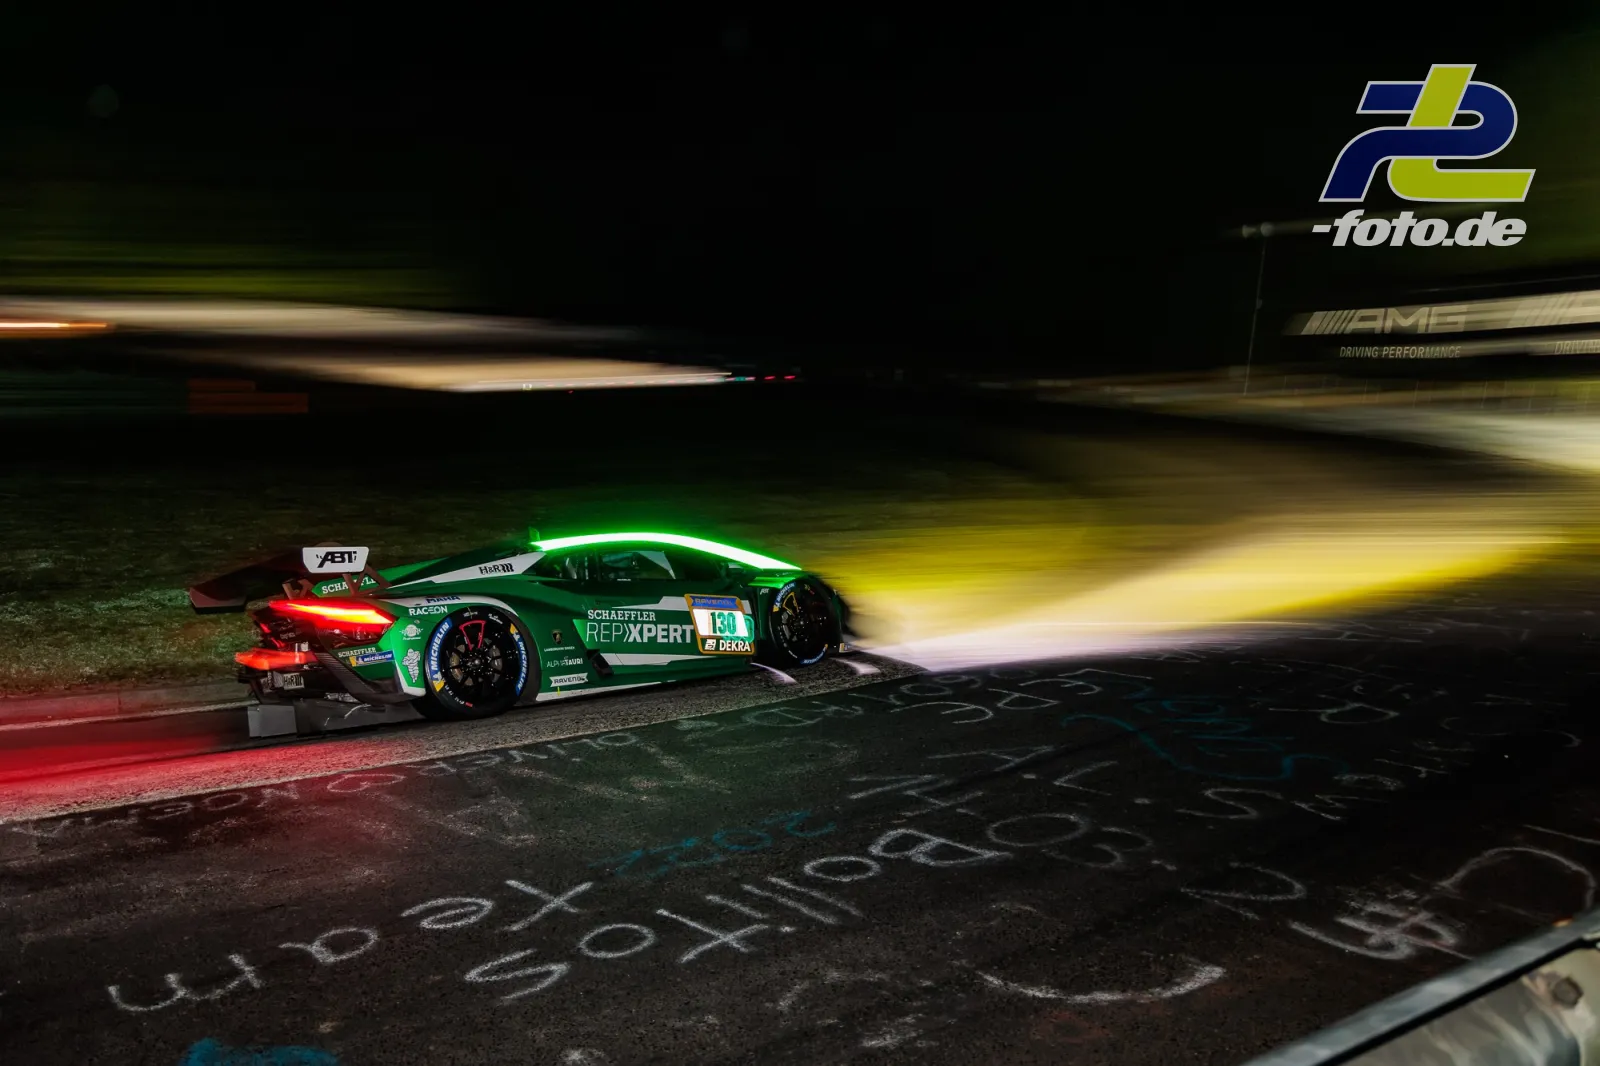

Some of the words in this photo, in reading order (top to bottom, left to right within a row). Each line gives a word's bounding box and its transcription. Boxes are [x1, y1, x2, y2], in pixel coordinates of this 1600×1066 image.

[1347, 304, 1469, 335] AMG
[1339, 346, 1379, 359] DRIVING
[1382, 345, 1462, 359] PERFORMANCE
[316, 550, 358, 569] ABT
[587, 609, 656, 622] SCHAEFFLER
[710, 611, 737, 635] 130
[338, 646, 377, 658] SCHAEFFLER
[430, 622, 450, 671] MICHELIN
[719, 639, 751, 652] DEKRA
[463, 827, 1014, 1001] Bollitos
